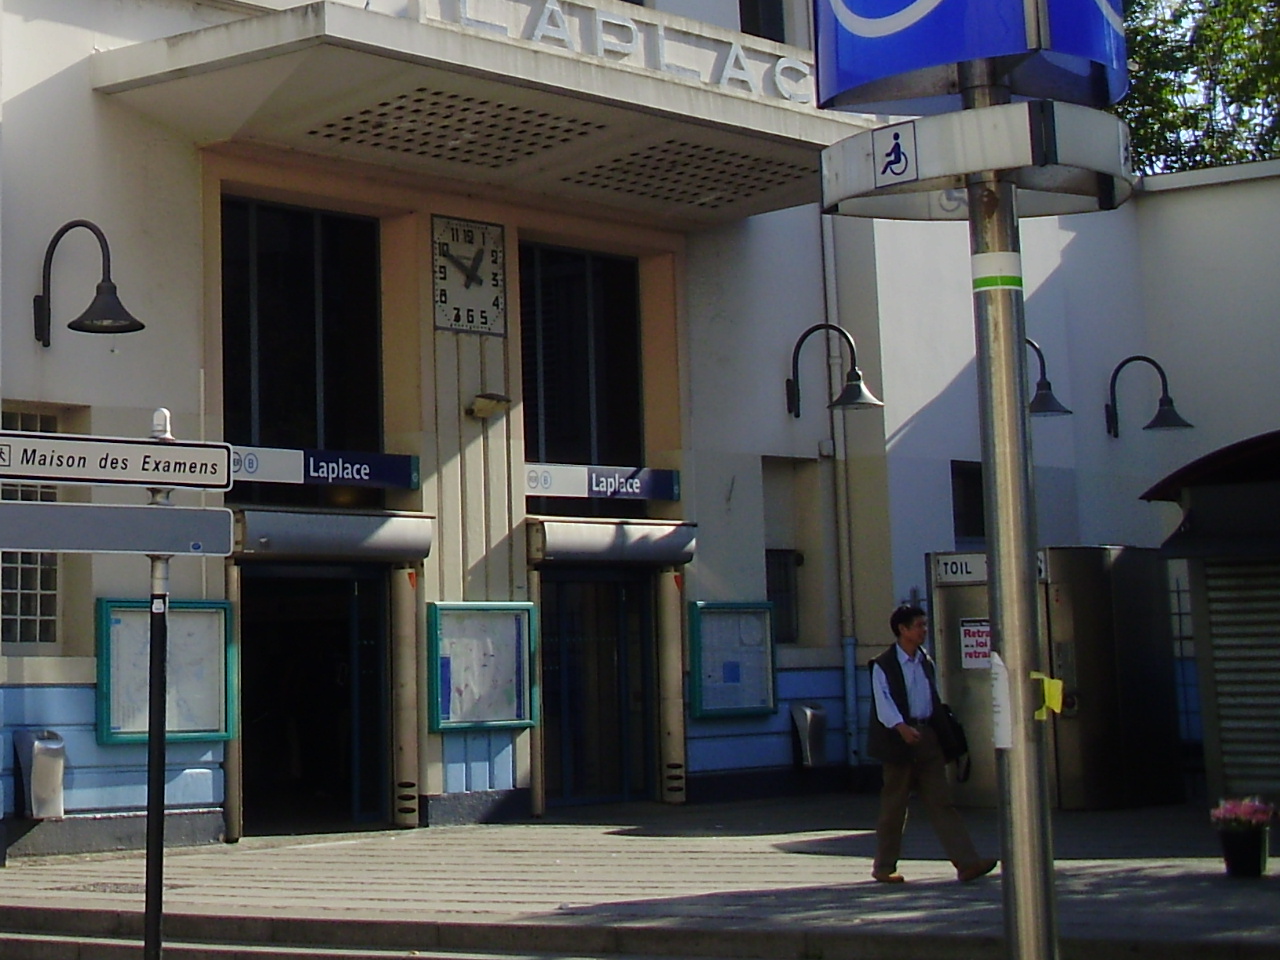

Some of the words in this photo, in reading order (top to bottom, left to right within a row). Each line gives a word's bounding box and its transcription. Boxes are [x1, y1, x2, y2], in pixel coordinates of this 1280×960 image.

[20, 447, 87, 470] Maison
[98, 451, 129, 471] des
[141, 454, 219, 476] Examens
[309, 457, 370, 483] Laplace
[592, 473, 641, 496] Laplace
